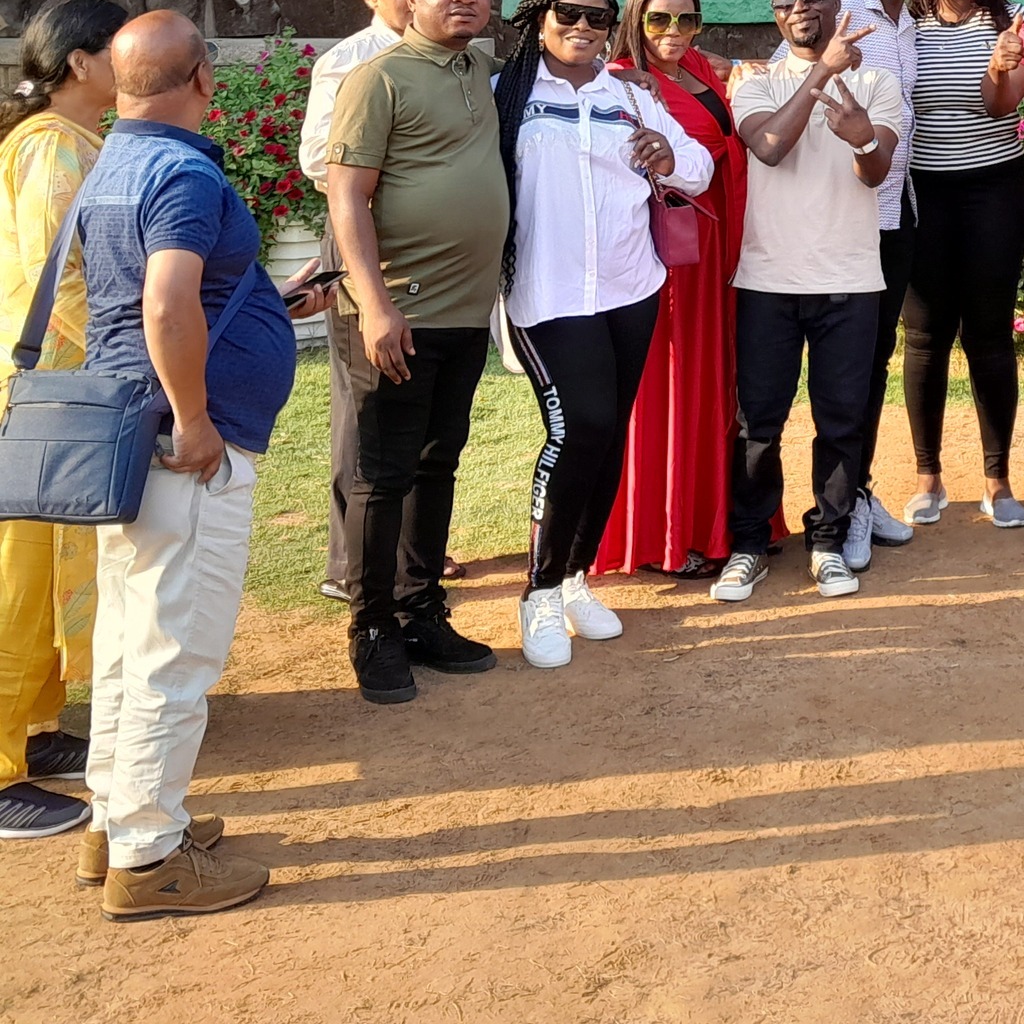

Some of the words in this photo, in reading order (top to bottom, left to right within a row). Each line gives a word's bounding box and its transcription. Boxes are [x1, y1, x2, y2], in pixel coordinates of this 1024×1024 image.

[523, 103, 547, 118] MY
[543, 386, 565, 445] TOMMY
[531, 444, 561, 521] HILFIGER
